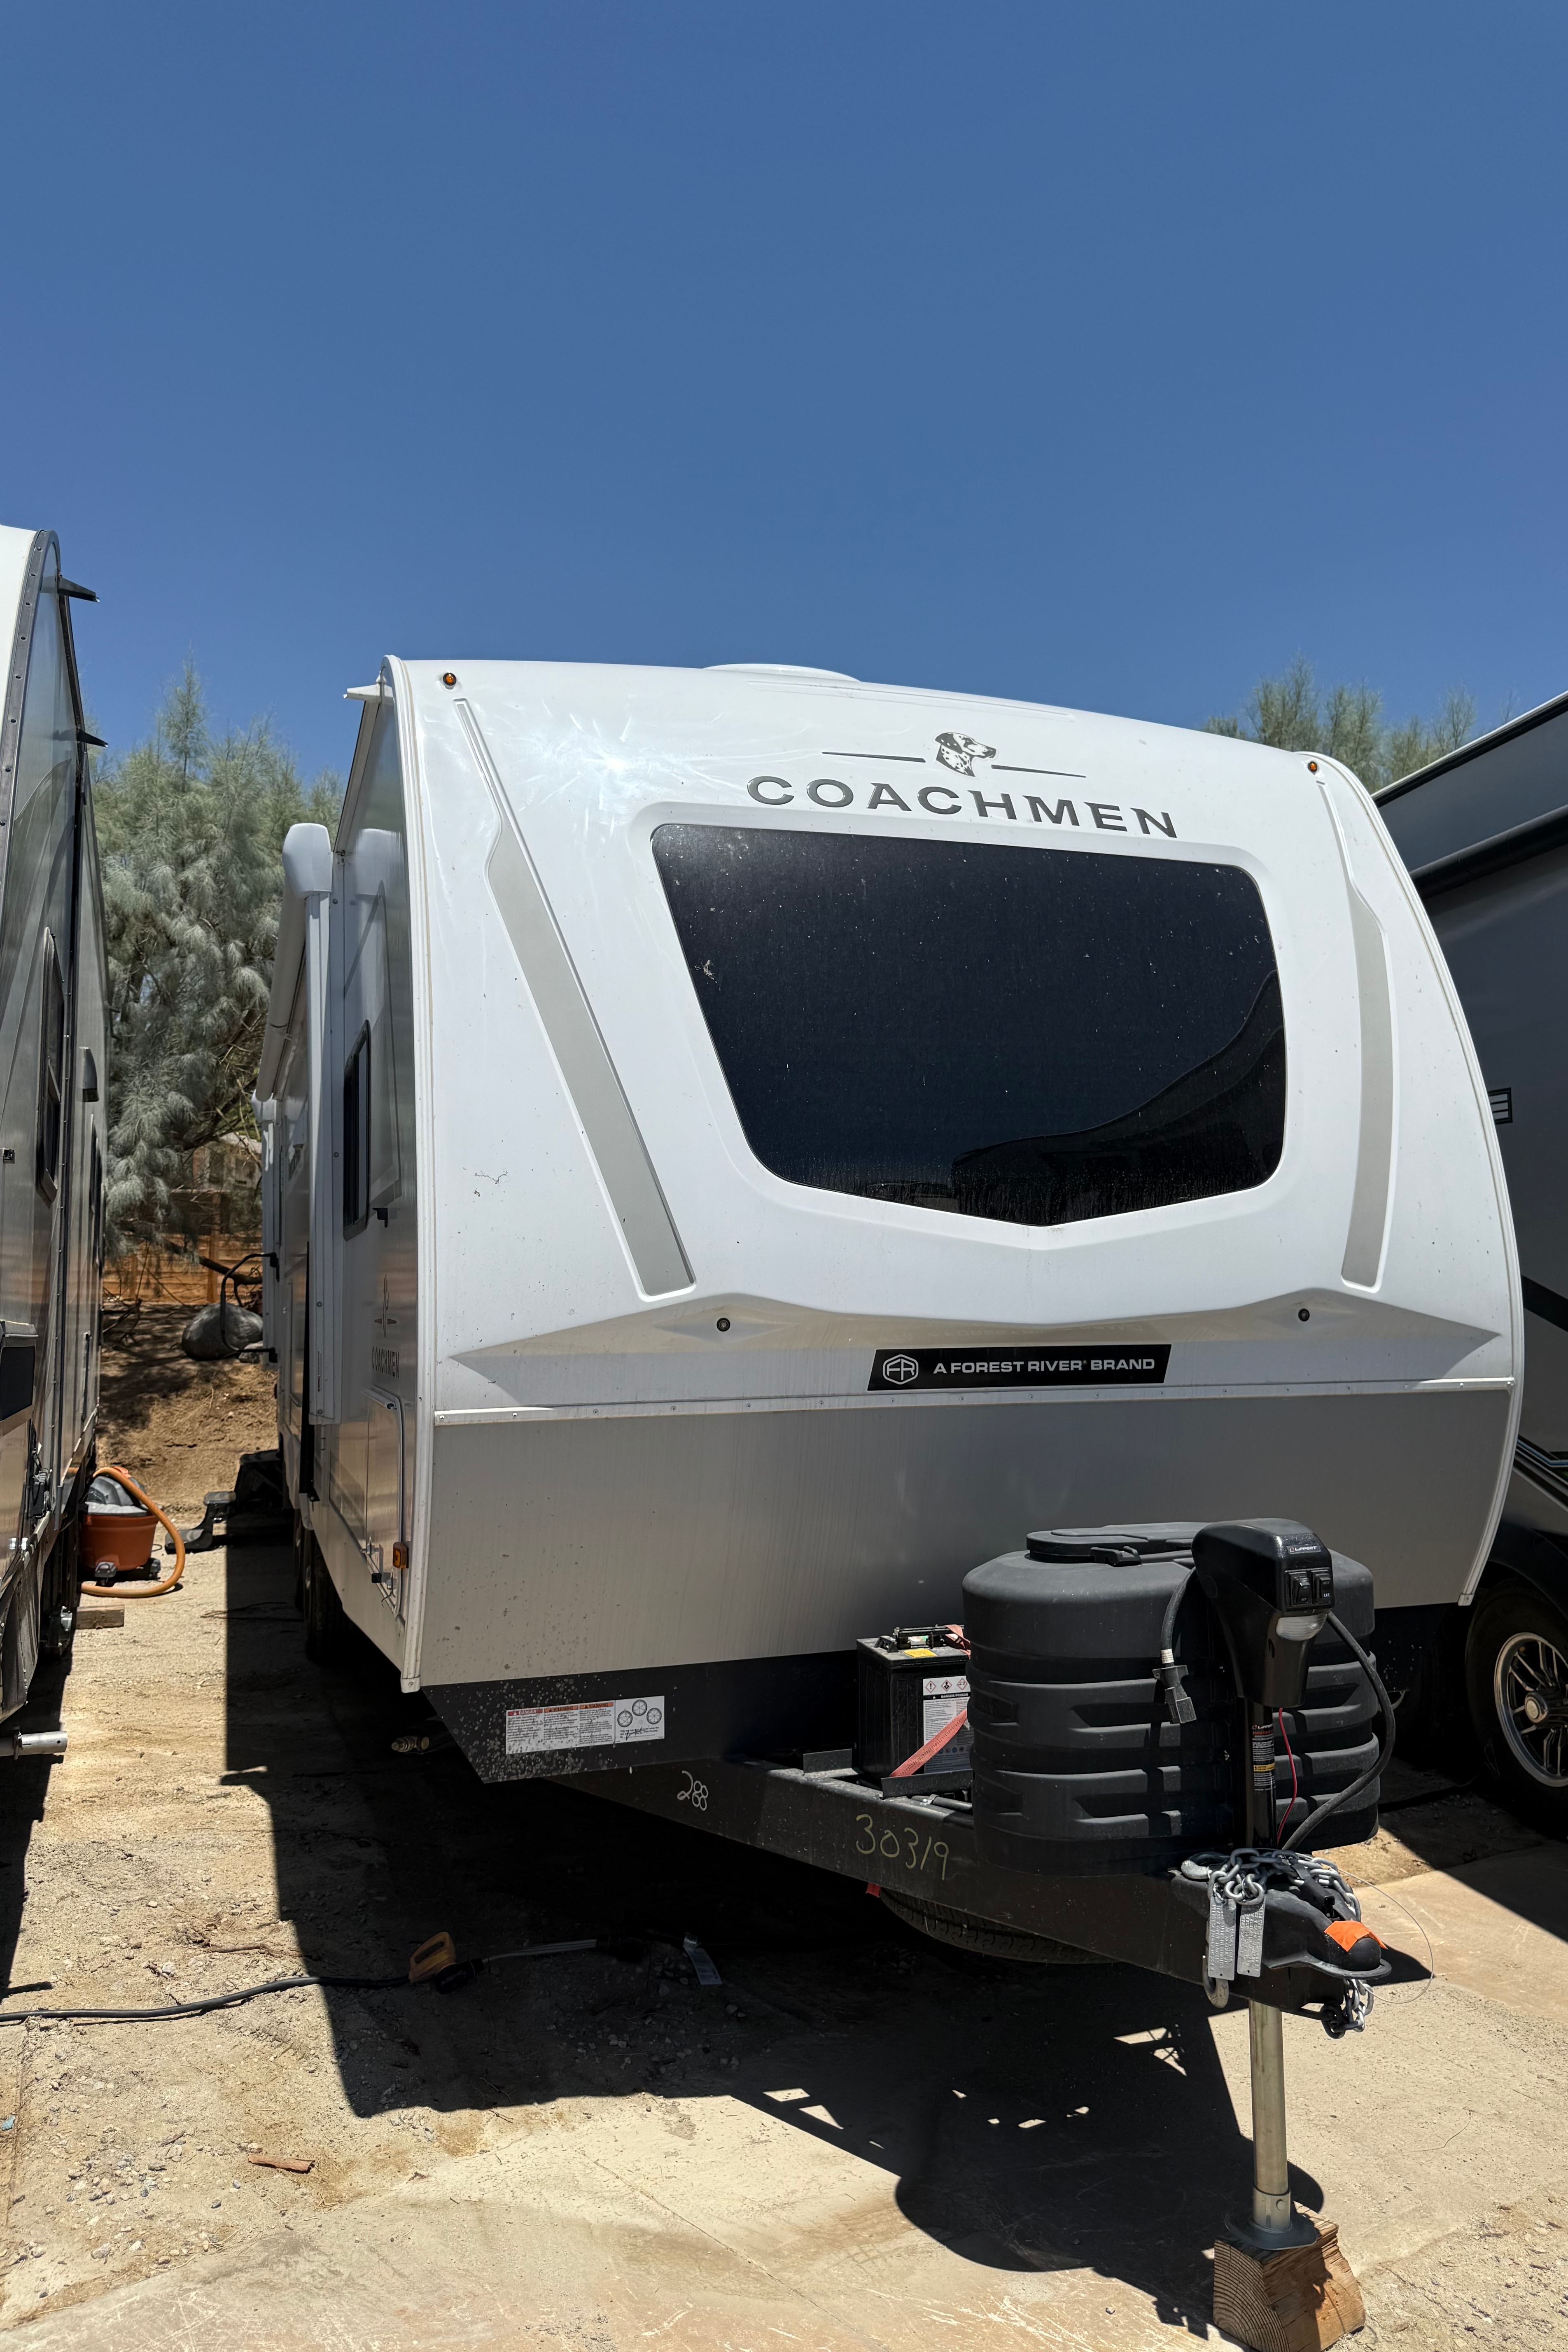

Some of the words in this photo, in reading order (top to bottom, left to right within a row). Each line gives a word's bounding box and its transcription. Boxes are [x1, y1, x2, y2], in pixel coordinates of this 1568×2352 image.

[747, 776, 1177, 838] COACHMEN
[372, 1346, 399, 1379] COACHMEN
[933, 1363, 947, 1374] A
[951, 1361, 1024, 1373] FOREST
[1091, 1359, 1155, 1370] BRAND
[856, 1814, 949, 1881] 30319
